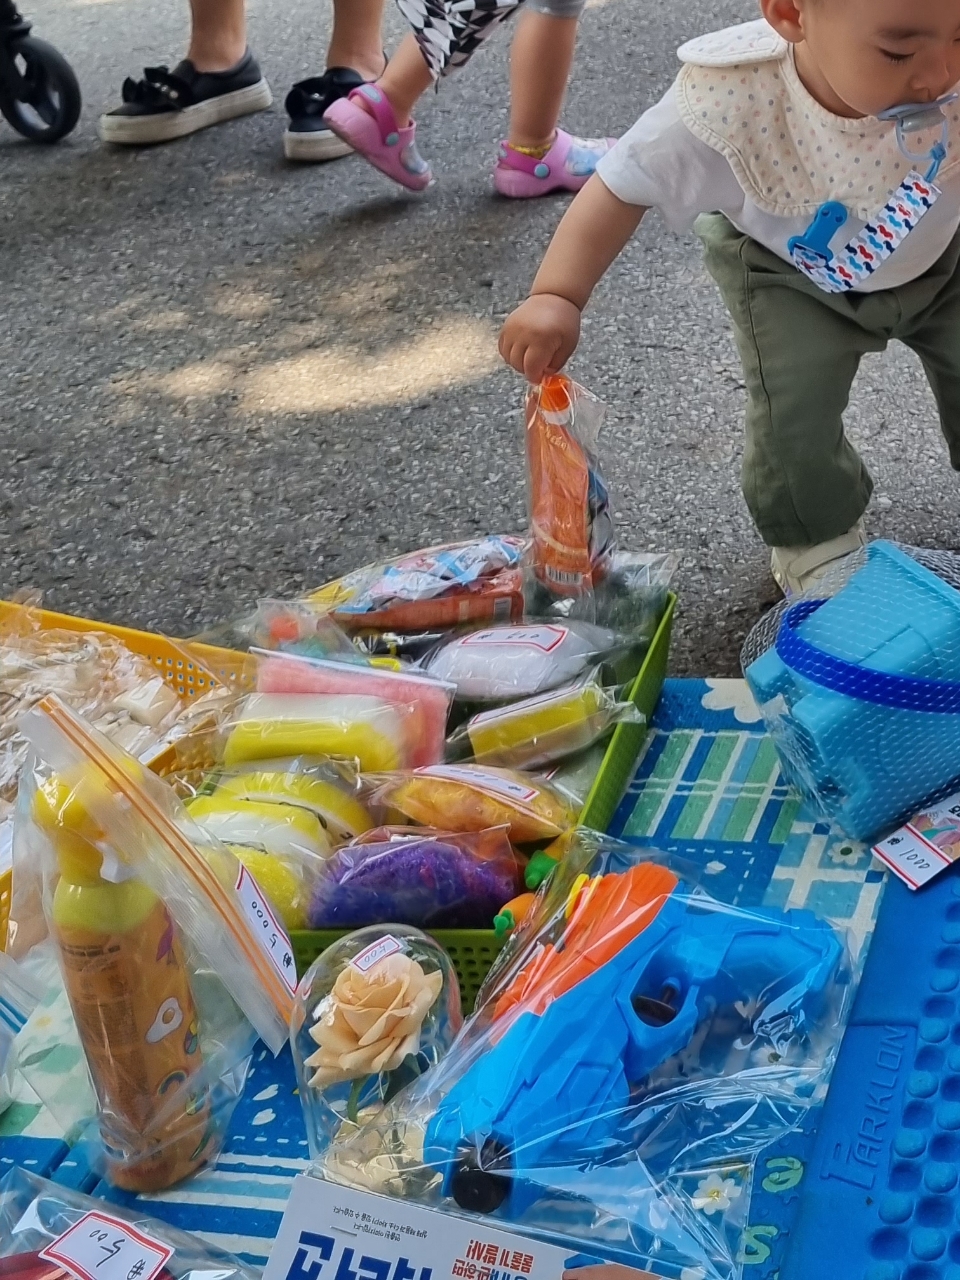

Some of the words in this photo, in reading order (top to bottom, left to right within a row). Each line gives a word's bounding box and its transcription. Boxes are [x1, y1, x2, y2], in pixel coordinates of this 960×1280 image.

[899, 848, 931, 870] 1000
[251, 901, 279, 949] 5000
[821, 1026, 908, 1191] PARKLON
[89, 1229, 126, 1268] 500
[465, 1239, 500, 1267] 발사!
[498, 1248, 534, 1274] 물줄기
